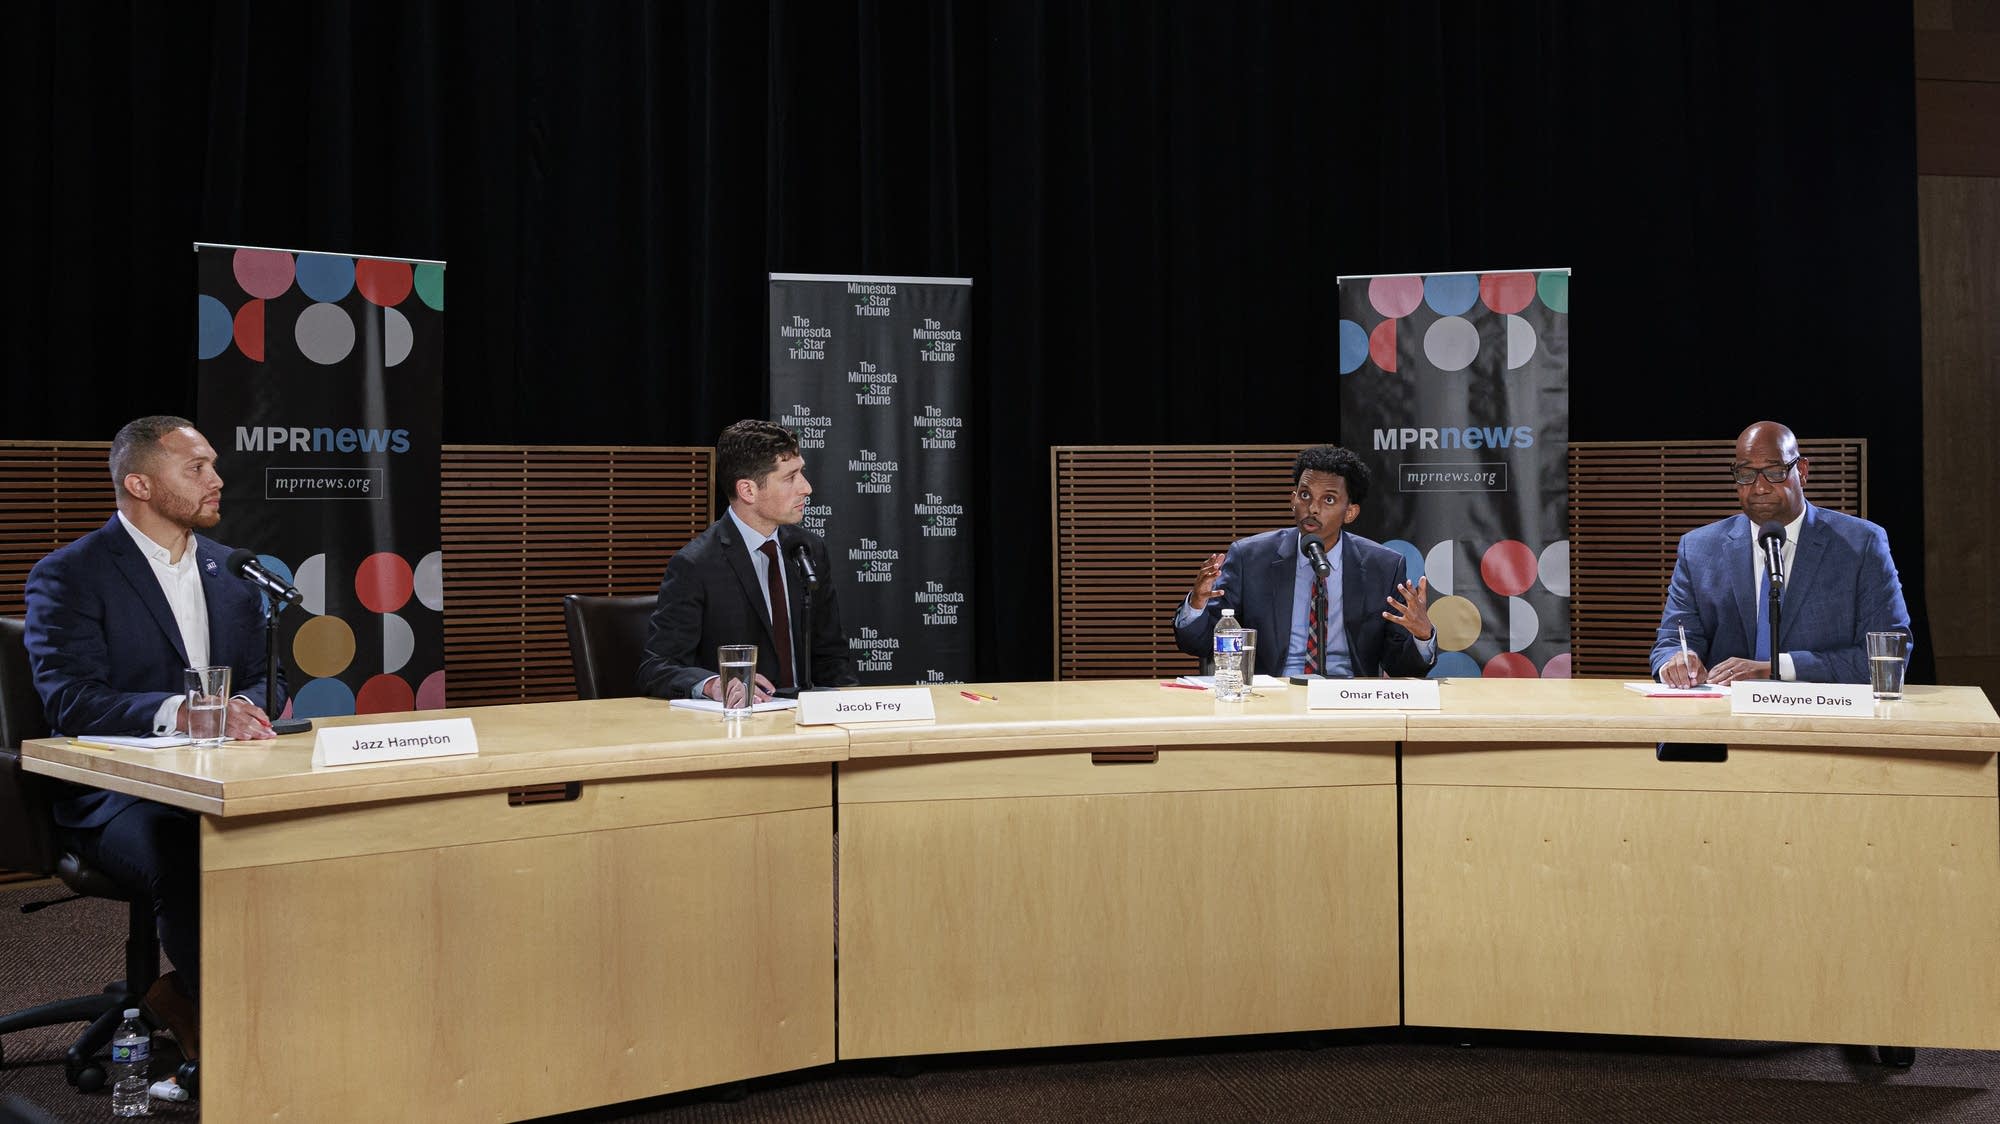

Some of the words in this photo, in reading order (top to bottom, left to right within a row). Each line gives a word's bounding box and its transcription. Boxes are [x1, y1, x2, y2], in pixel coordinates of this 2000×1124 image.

[847, 283, 896, 294] Minnesota
[869, 295, 891, 306] Star
[855, 305, 890, 316] Tribune
[793, 316, 809, 327] The
[924, 319, 940, 330] The
[781, 326, 831, 337] Minnesota
[913, 329, 961, 340] Minnesota
[804, 339, 825, 350] Star
[935, 341, 956, 351] Star
[789, 348, 824, 360] Tribune
[921, 351, 954, 361] Tribune
[860, 362, 876, 372] The
[848, 372, 897, 383] Minnesota
[870, 384, 892, 394] Star
[856, 394, 890, 405] Tribune
[793, 404, 810, 416] The
[925, 406, 941, 416] The
[782, 415, 832, 426] Minnesota
[914, 416, 962, 426] Minnesota
[804, 427, 826, 438] Star
[936, 428, 956, 438] Star
[922, 438, 956, 448] Tribune
[860, 450, 876, 460] The
[849, 460, 898, 471] Minnesota
[871, 472, 892, 482] Star
[1407, 470, 1496, 485] mprnews.org
[276, 477, 371, 492] mprnews.org
[856, 482, 891, 493] Tribune
[926, 494, 942, 504] The
[802, 505, 832, 515] esota
[914, 504, 962, 514] Minnesota
[804, 516, 826, 528] Star
[936, 516, 957, 526] Star
[922, 526, 956, 536] Tribune
[860, 538, 877, 549] The
[849, 549, 898, 560] Minnesota
[871, 561, 892, 572] Star
[857, 571, 892, 582] Tribune
[926, 582, 942, 592] The
[916, 592, 964, 602] Minnesota
[937, 604, 958, 614] Star
[923, 614, 957, 624] Tribune
[861, 628, 878, 639] The
[850, 638, 899, 649] Minnesota
[872, 650, 893, 660] Star
[857, 660, 892, 671] Tribune
[927, 670, 944, 681] The
[1340, 690, 1372, 699] Omar
[1376, 690, 1408, 700] Fateh
[1752, 694, 1812, 706] DeWayne
[1817, 696, 1852, 706] Davis
[836, 702, 872, 712] Jacob
[876, 702, 901, 712] Frey
[352, 739, 384, 750] Jazz
[388, 734, 450, 748] Hampton
